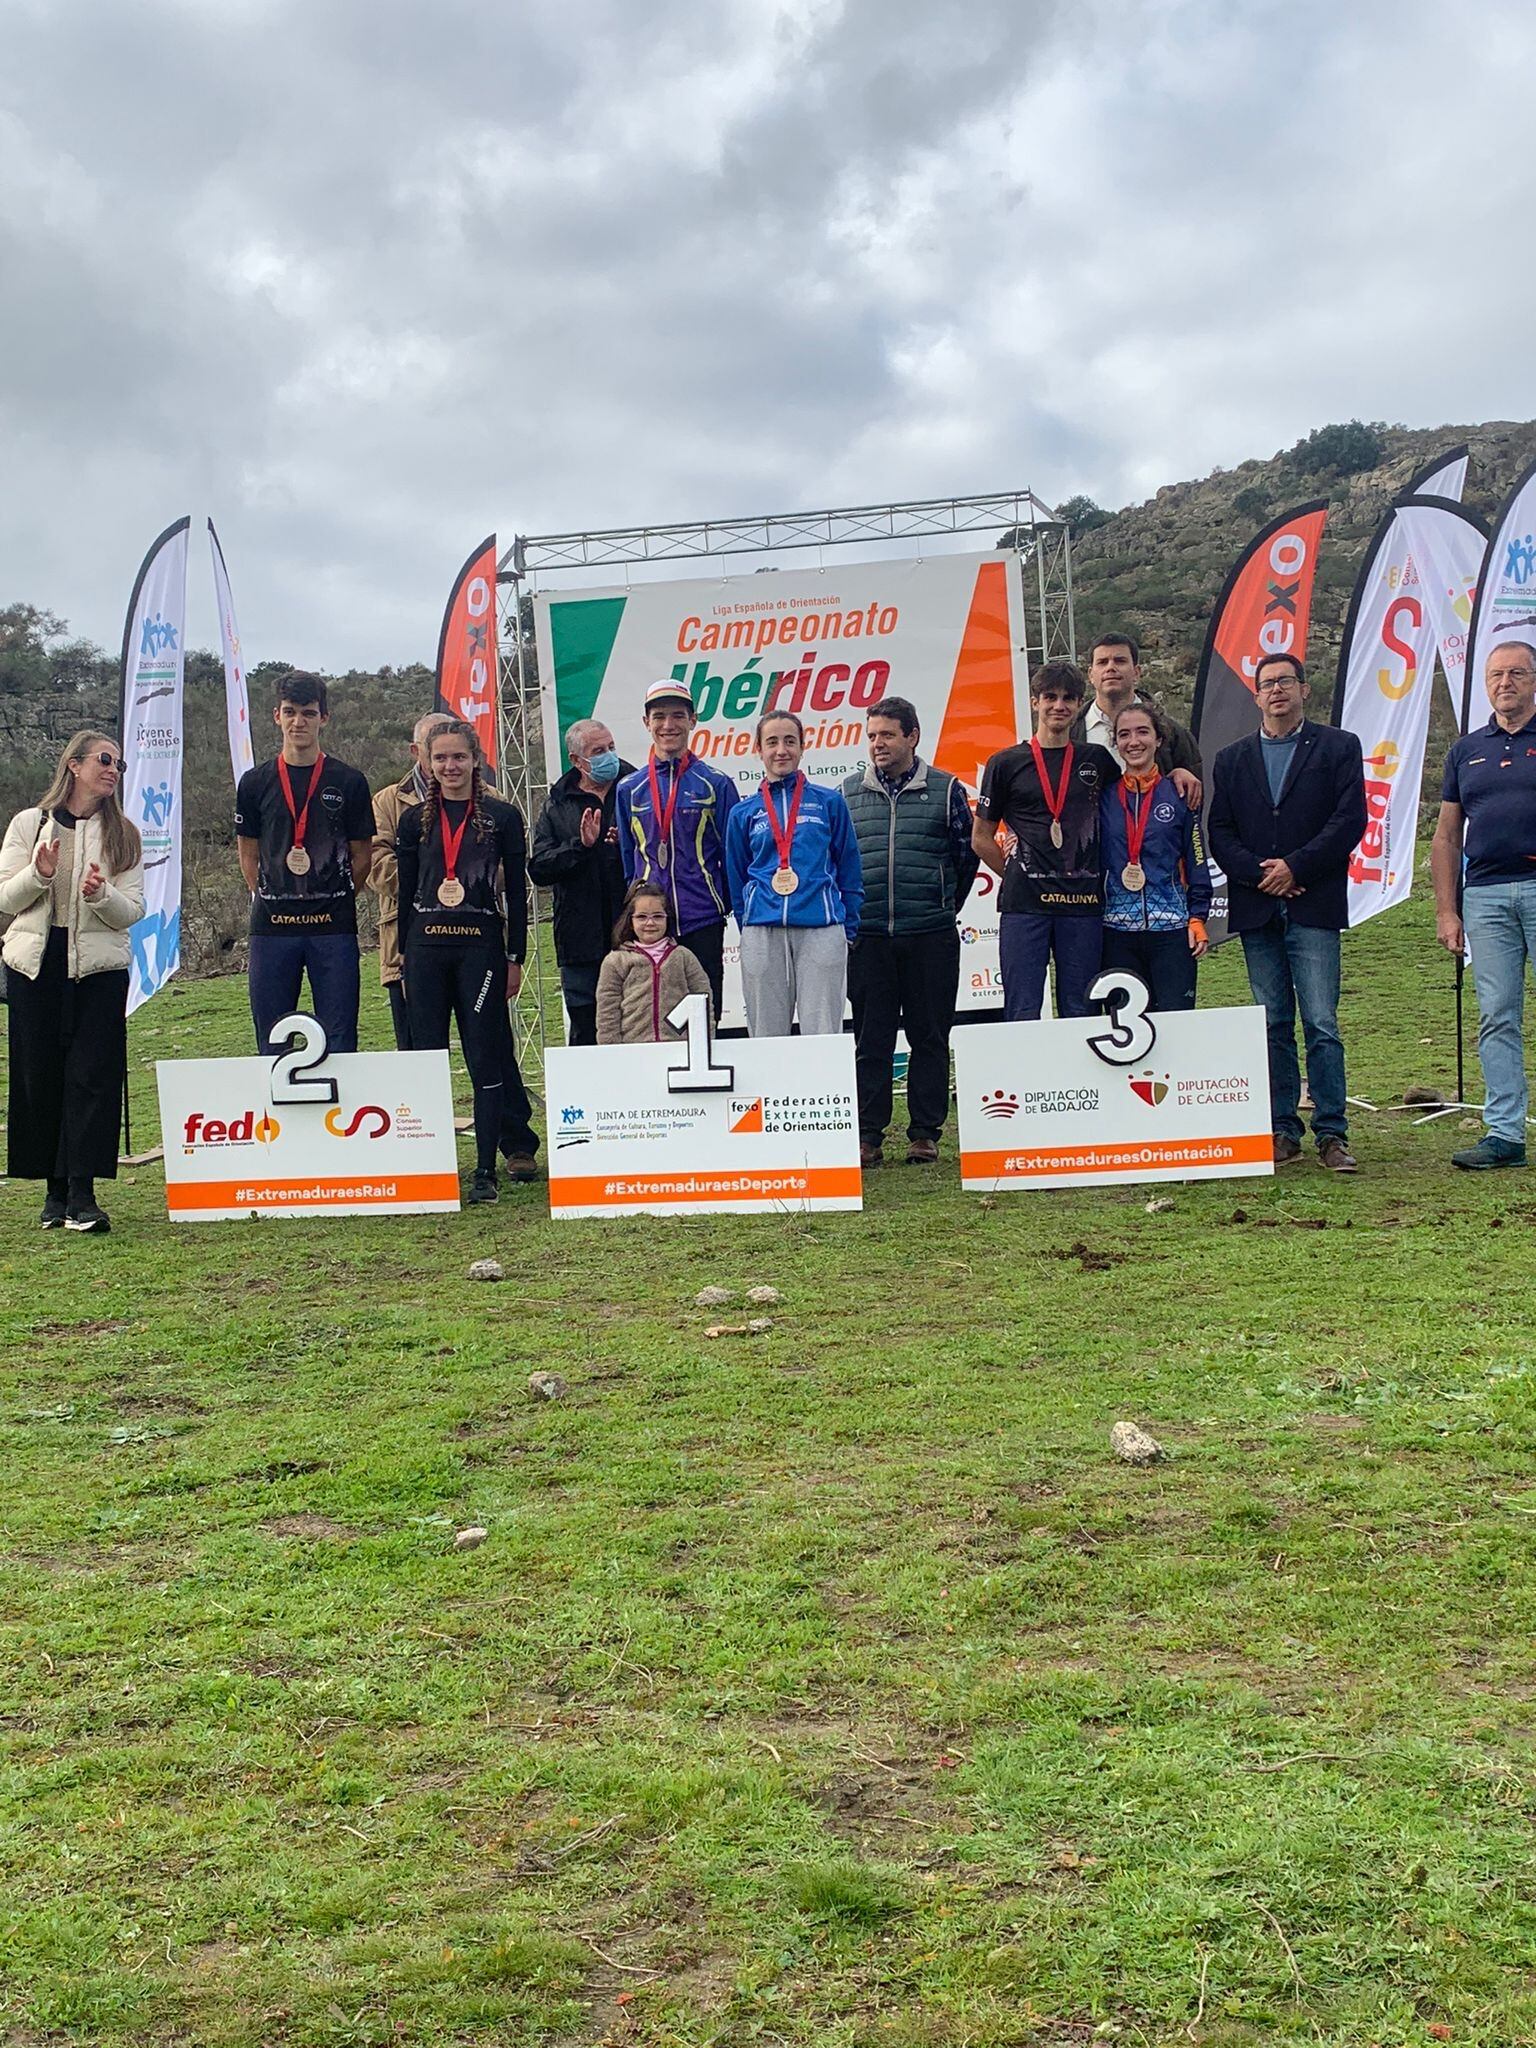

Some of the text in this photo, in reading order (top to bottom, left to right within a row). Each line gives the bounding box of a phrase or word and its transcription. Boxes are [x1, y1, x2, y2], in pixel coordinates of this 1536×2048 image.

[713, 596, 840, 616] Liga Española de Orientación
[677, 602, 899, 653] Campeonato
[459, 576, 491, 722] fexo
[808, 765, 847, 776] Larga
[1040, 893, 1098, 904] CATALUNYA
[271, 914, 333, 924] CATALUNYA
[425, 925, 482, 936] CATALUNYA
[474, 970, 493, 1013] noname
[1085, 967, 1156, 1066] 3
[664, 992, 734, 1093] 1
[268, 1011, 338, 1105] 2
[1177, 1077, 1250, 1091] DIPUTACIÓN
[764, 1094, 851, 1107] Federación
[1025, 1086, 1099, 1103] DIPUTACIÓN
[1178, 1091, 1250, 1105] DE CÁCERES
[731, 1101, 759, 1112] fexo
[1040, 1099, 1099, 1113] BADAJOZ
[596, 1108, 706, 1121] JUNTA DE EXTREMADURA
[765, 1107, 851, 1120] Extremeña
[765, 1119, 852, 1132] de Orientación
[407, 1131, 435, 1139] Deportes
[1004, 1145, 1233, 1171] #ExtremaduraesOrientación
[235, 1183, 397, 1202] #ExtremaduraesRaid
[604, 1176, 807, 1196] #ExtremaduraesDeporte
